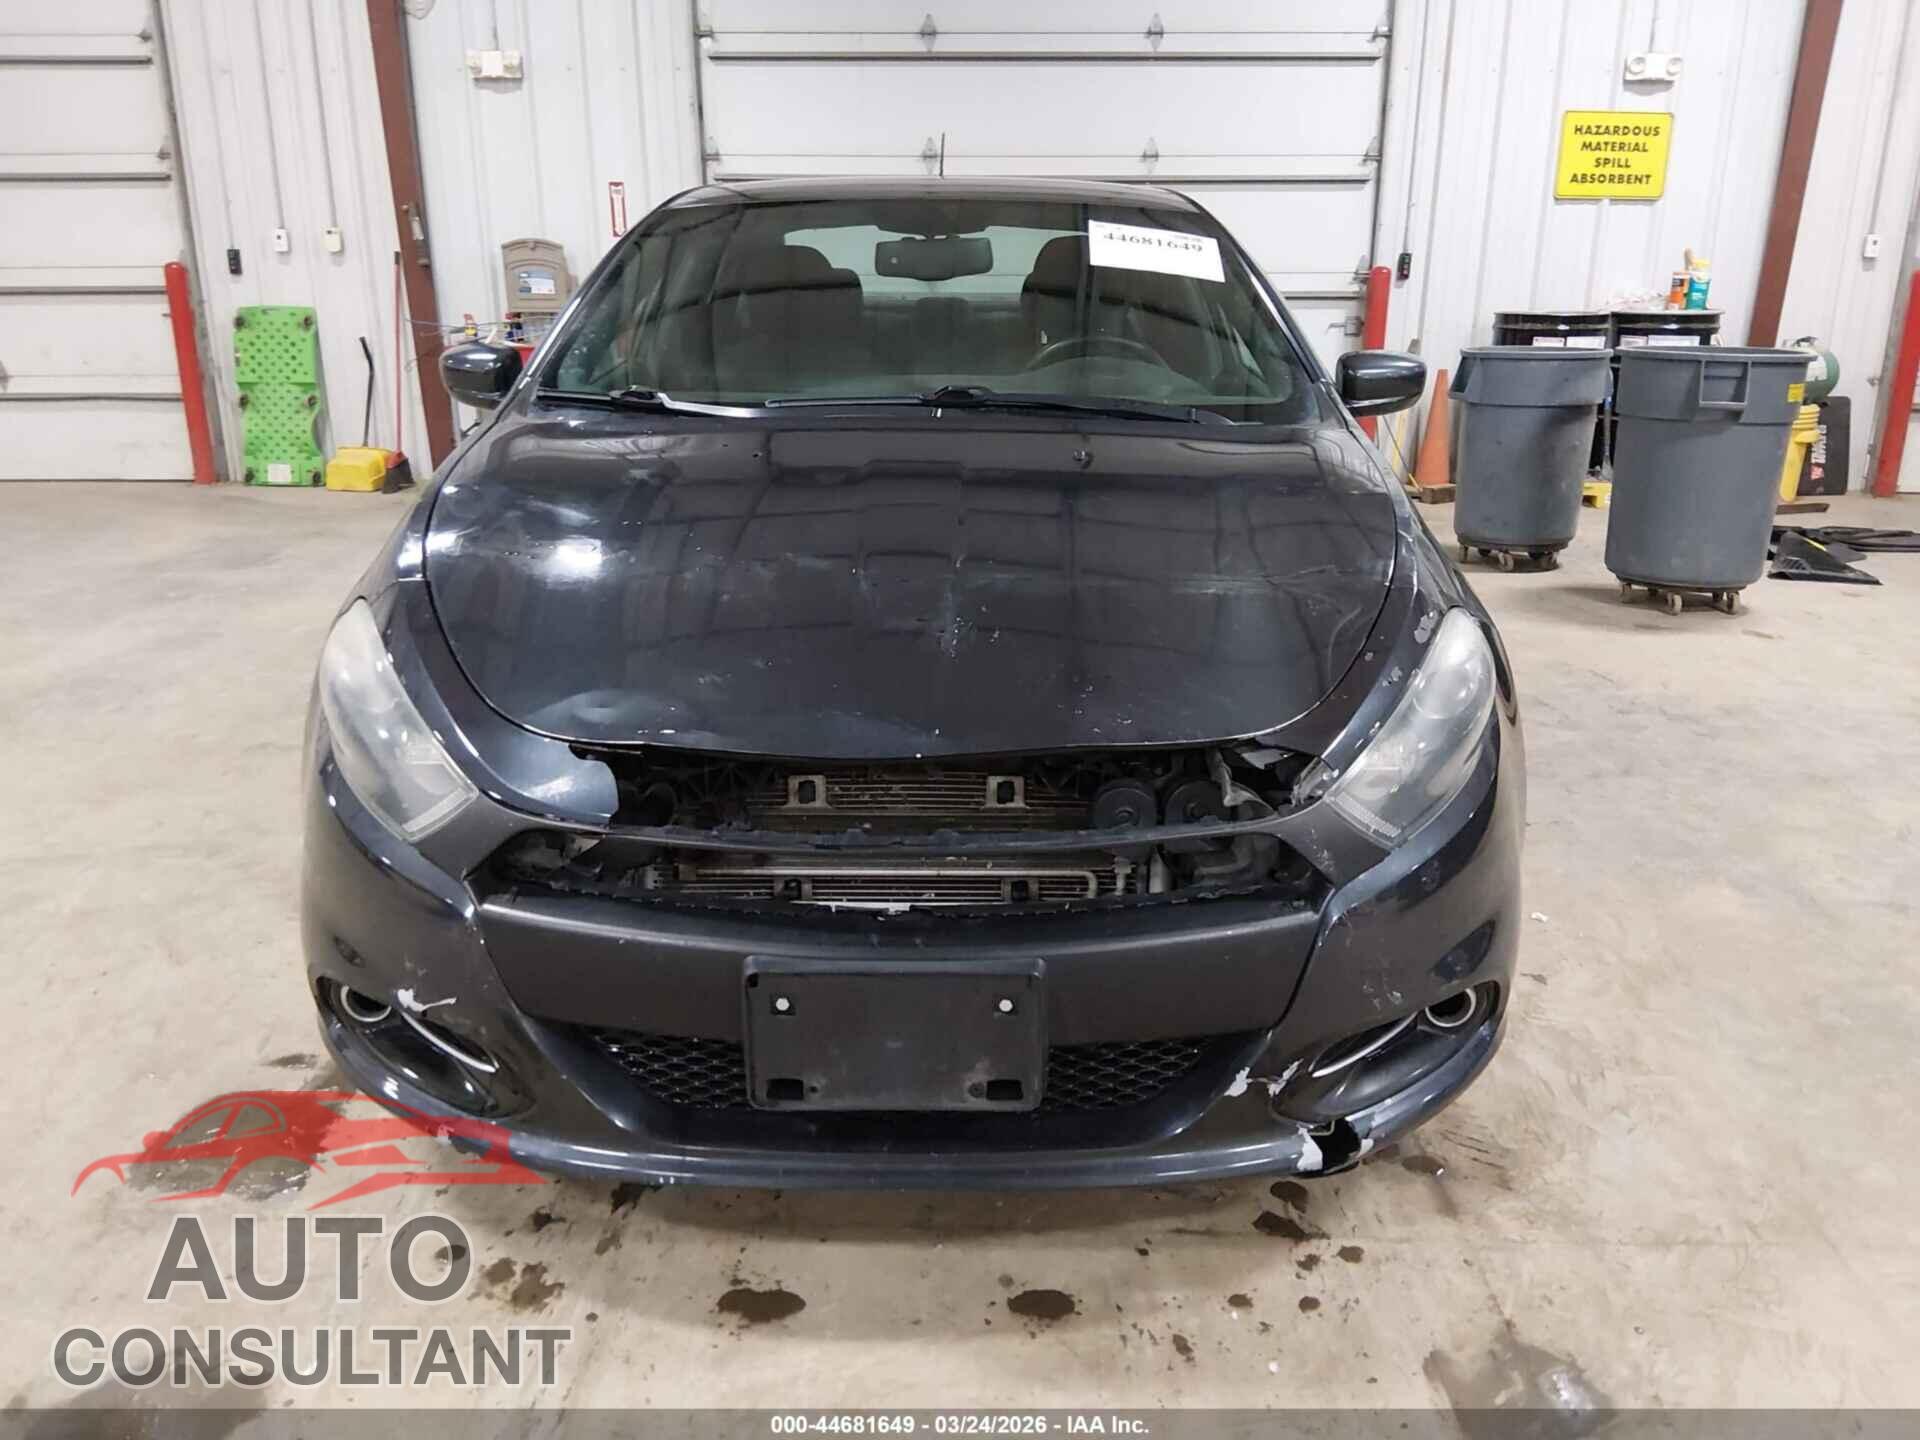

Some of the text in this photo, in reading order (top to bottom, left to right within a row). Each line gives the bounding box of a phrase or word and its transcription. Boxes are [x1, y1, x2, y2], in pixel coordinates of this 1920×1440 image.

[1574, 124, 1660, 136] HAZARDOUS
[1580, 141, 1648, 152] MATERIAL
[1594, 157, 1631, 168] SPILL
[1569, 173, 1652, 184] ABSORBENT
[1104, 232, 1203, 251] 44681649
